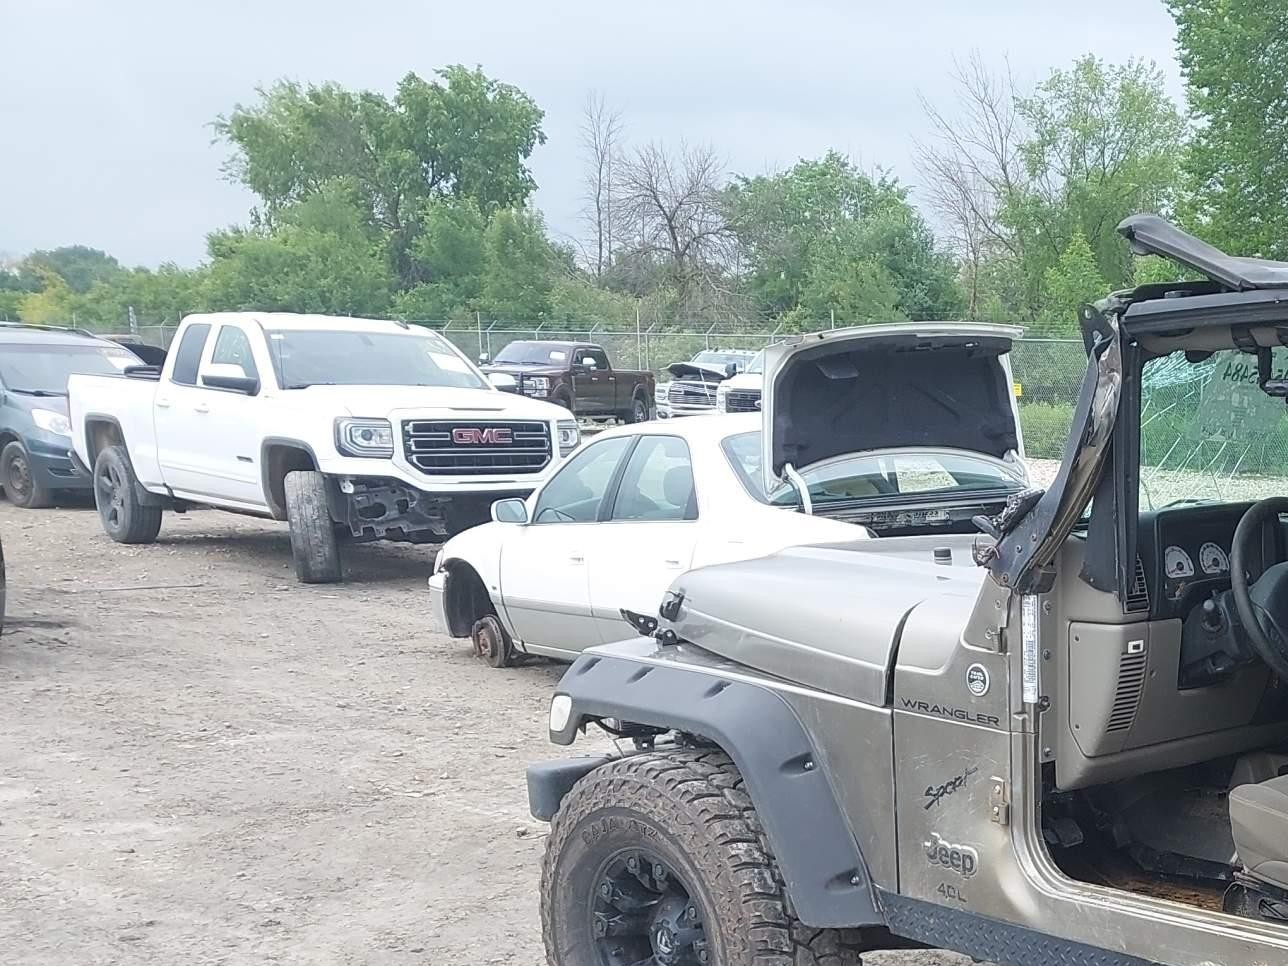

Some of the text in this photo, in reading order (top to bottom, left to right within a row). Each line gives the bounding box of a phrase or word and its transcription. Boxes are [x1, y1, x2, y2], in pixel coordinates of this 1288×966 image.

[452, 428, 513, 444] GMC
[901, 697, 1000, 727] WRANGLER
[924, 833, 978, 880] Jeep
